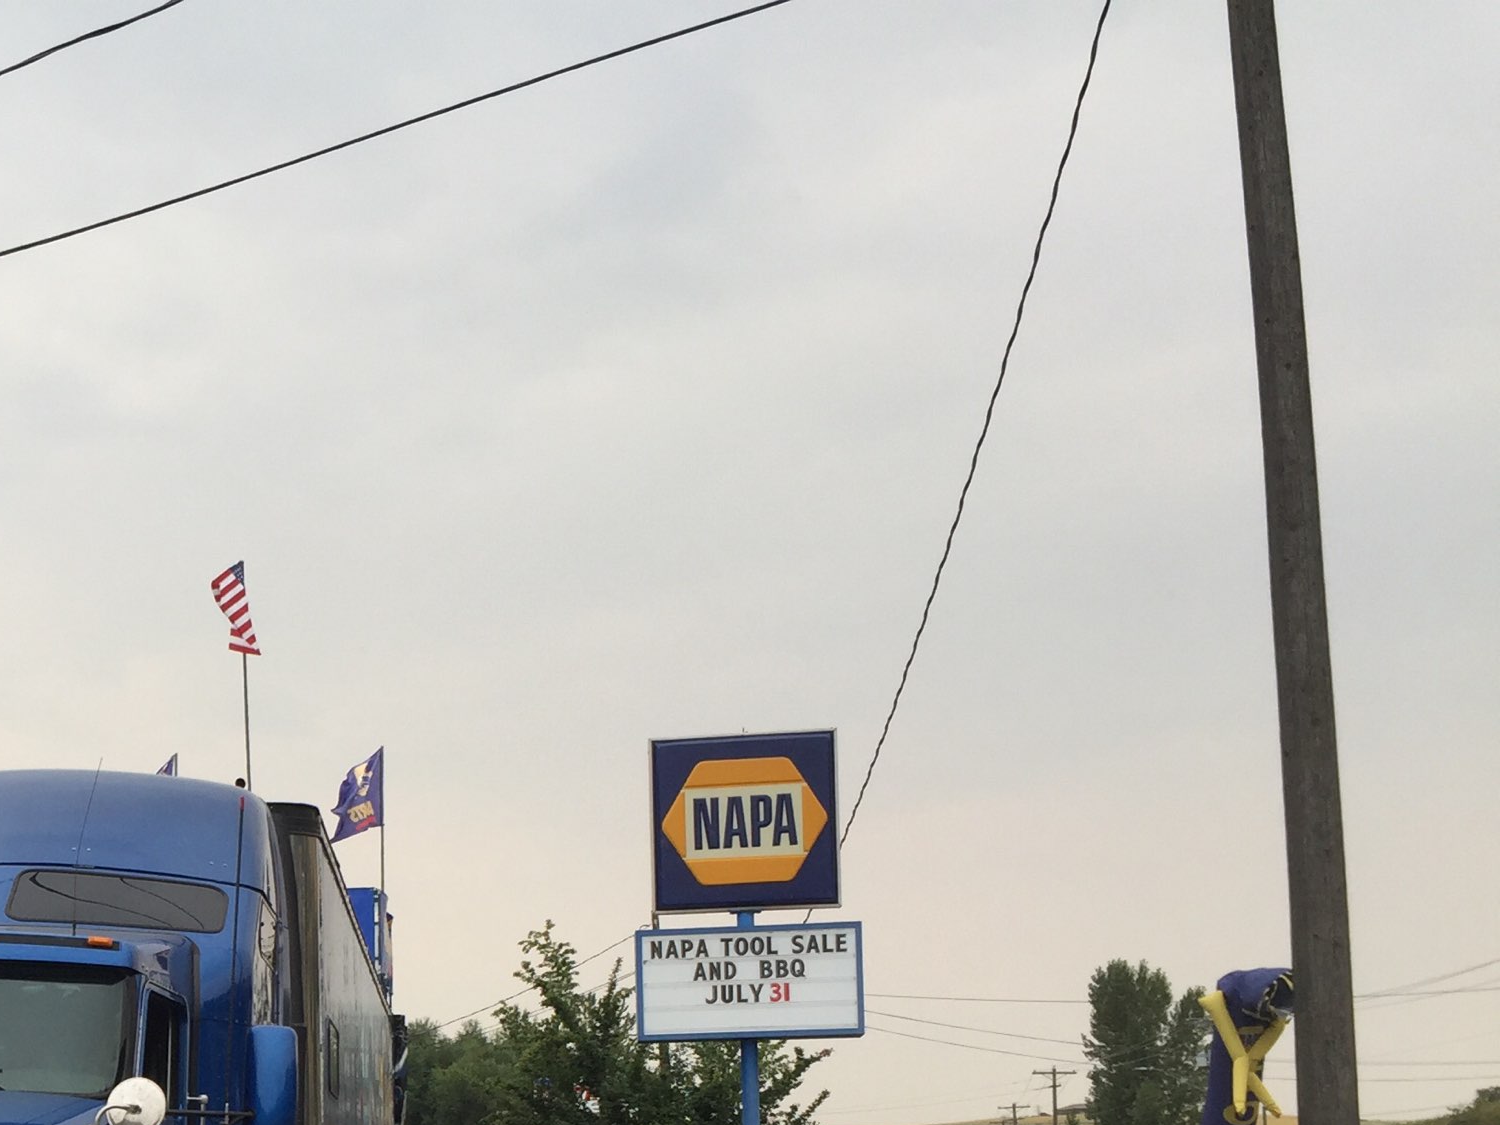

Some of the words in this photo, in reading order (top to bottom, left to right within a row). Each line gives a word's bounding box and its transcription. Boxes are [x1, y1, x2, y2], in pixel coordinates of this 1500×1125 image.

[693, 793, 799, 851] NAPA
[650, 939, 710, 960] NAPA
[720, 936, 778, 957] TOOL
[791, 933, 848, 953] SALE
[693, 962, 738, 982] AND
[759, 959, 806, 980] BBQ
[705, 984, 764, 1005] JULY
[769, 983, 791, 1003] 31
